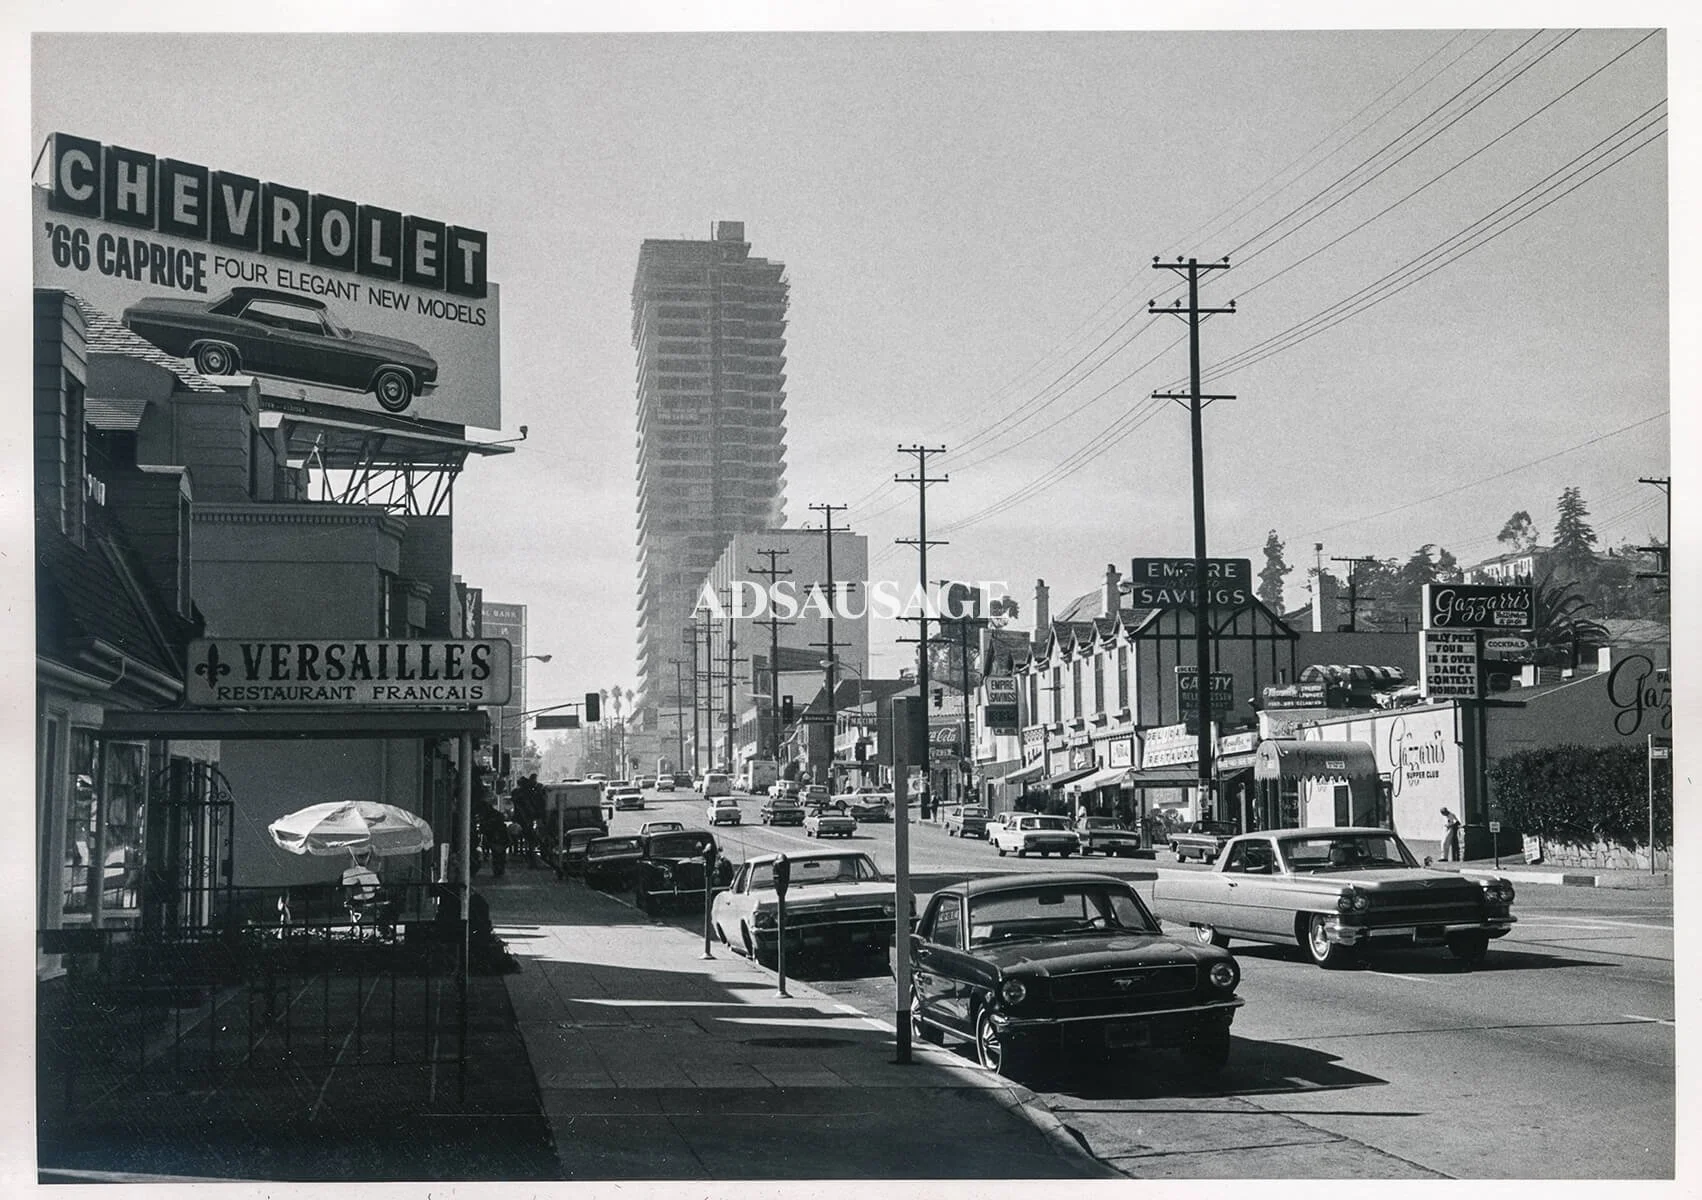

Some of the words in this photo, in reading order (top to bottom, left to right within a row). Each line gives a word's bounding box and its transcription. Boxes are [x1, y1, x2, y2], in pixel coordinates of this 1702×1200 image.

[60, 149, 481, 285] CHEVROLET
[45, 222, 91, 272] '66
[97, 233, 208, 294] CAPRICE
[214, 256, 268, 284] FOUR
[277, 268, 360, 302] ELEGANT
[369, 287, 410, 311] NEW
[418, 299, 486, 326] MODELS
[1433, 589, 1530, 627] Gazzarri's
[1435, 645, 1463, 653] FOUR
[1487, 640, 1526, 648] COCKTAILS
[240, 643, 491, 681] VERSAILLES
[1450, 655, 1475, 664] OVER
[1434, 665, 1472, 674] DANCE
[991, 680, 1014, 690] EMPIRE
[1427, 675, 1475, 685] CONTEST
[217, 686, 356, 700] RESTAURANT
[372, 686, 484, 700] FRANCAIS
[1429, 686, 1475, 695] MONDAYS
[1406, 770, 1425, 779] SUPPER
[1426, 770, 1440, 778] CLUB
